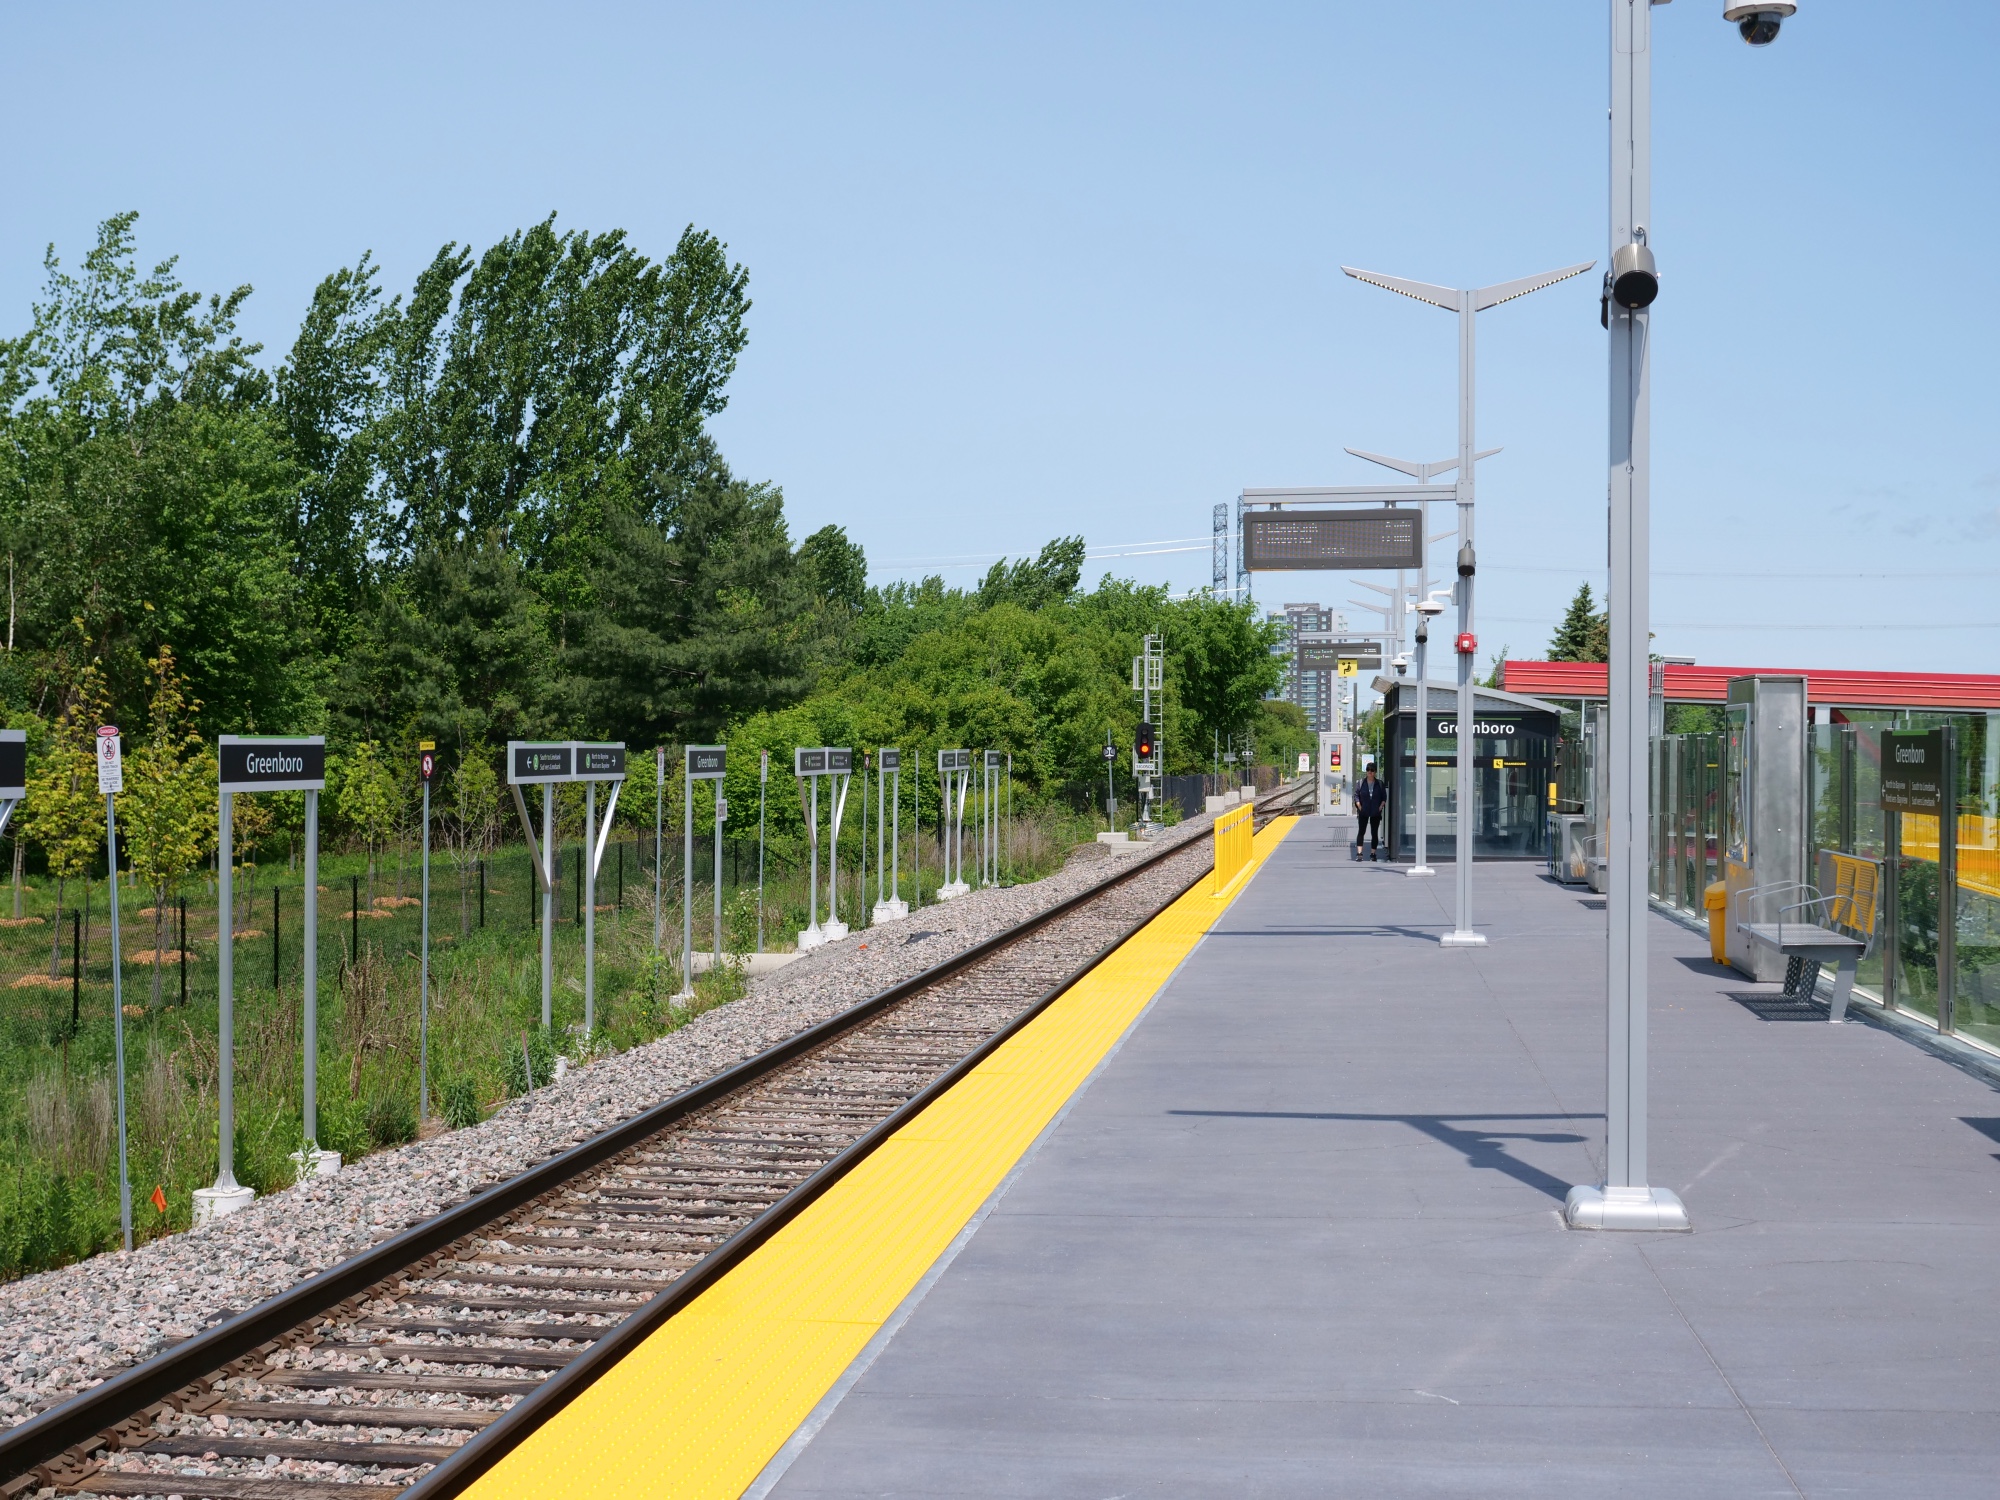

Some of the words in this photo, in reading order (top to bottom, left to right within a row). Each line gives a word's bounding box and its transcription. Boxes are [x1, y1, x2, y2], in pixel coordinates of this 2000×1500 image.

[1438, 722, 1514, 734] Grnboro
[697, 755, 719, 769] Greenboro
[1896, 743, 1924, 764] Greenboro
[246, 751, 303, 774] Greenboro
